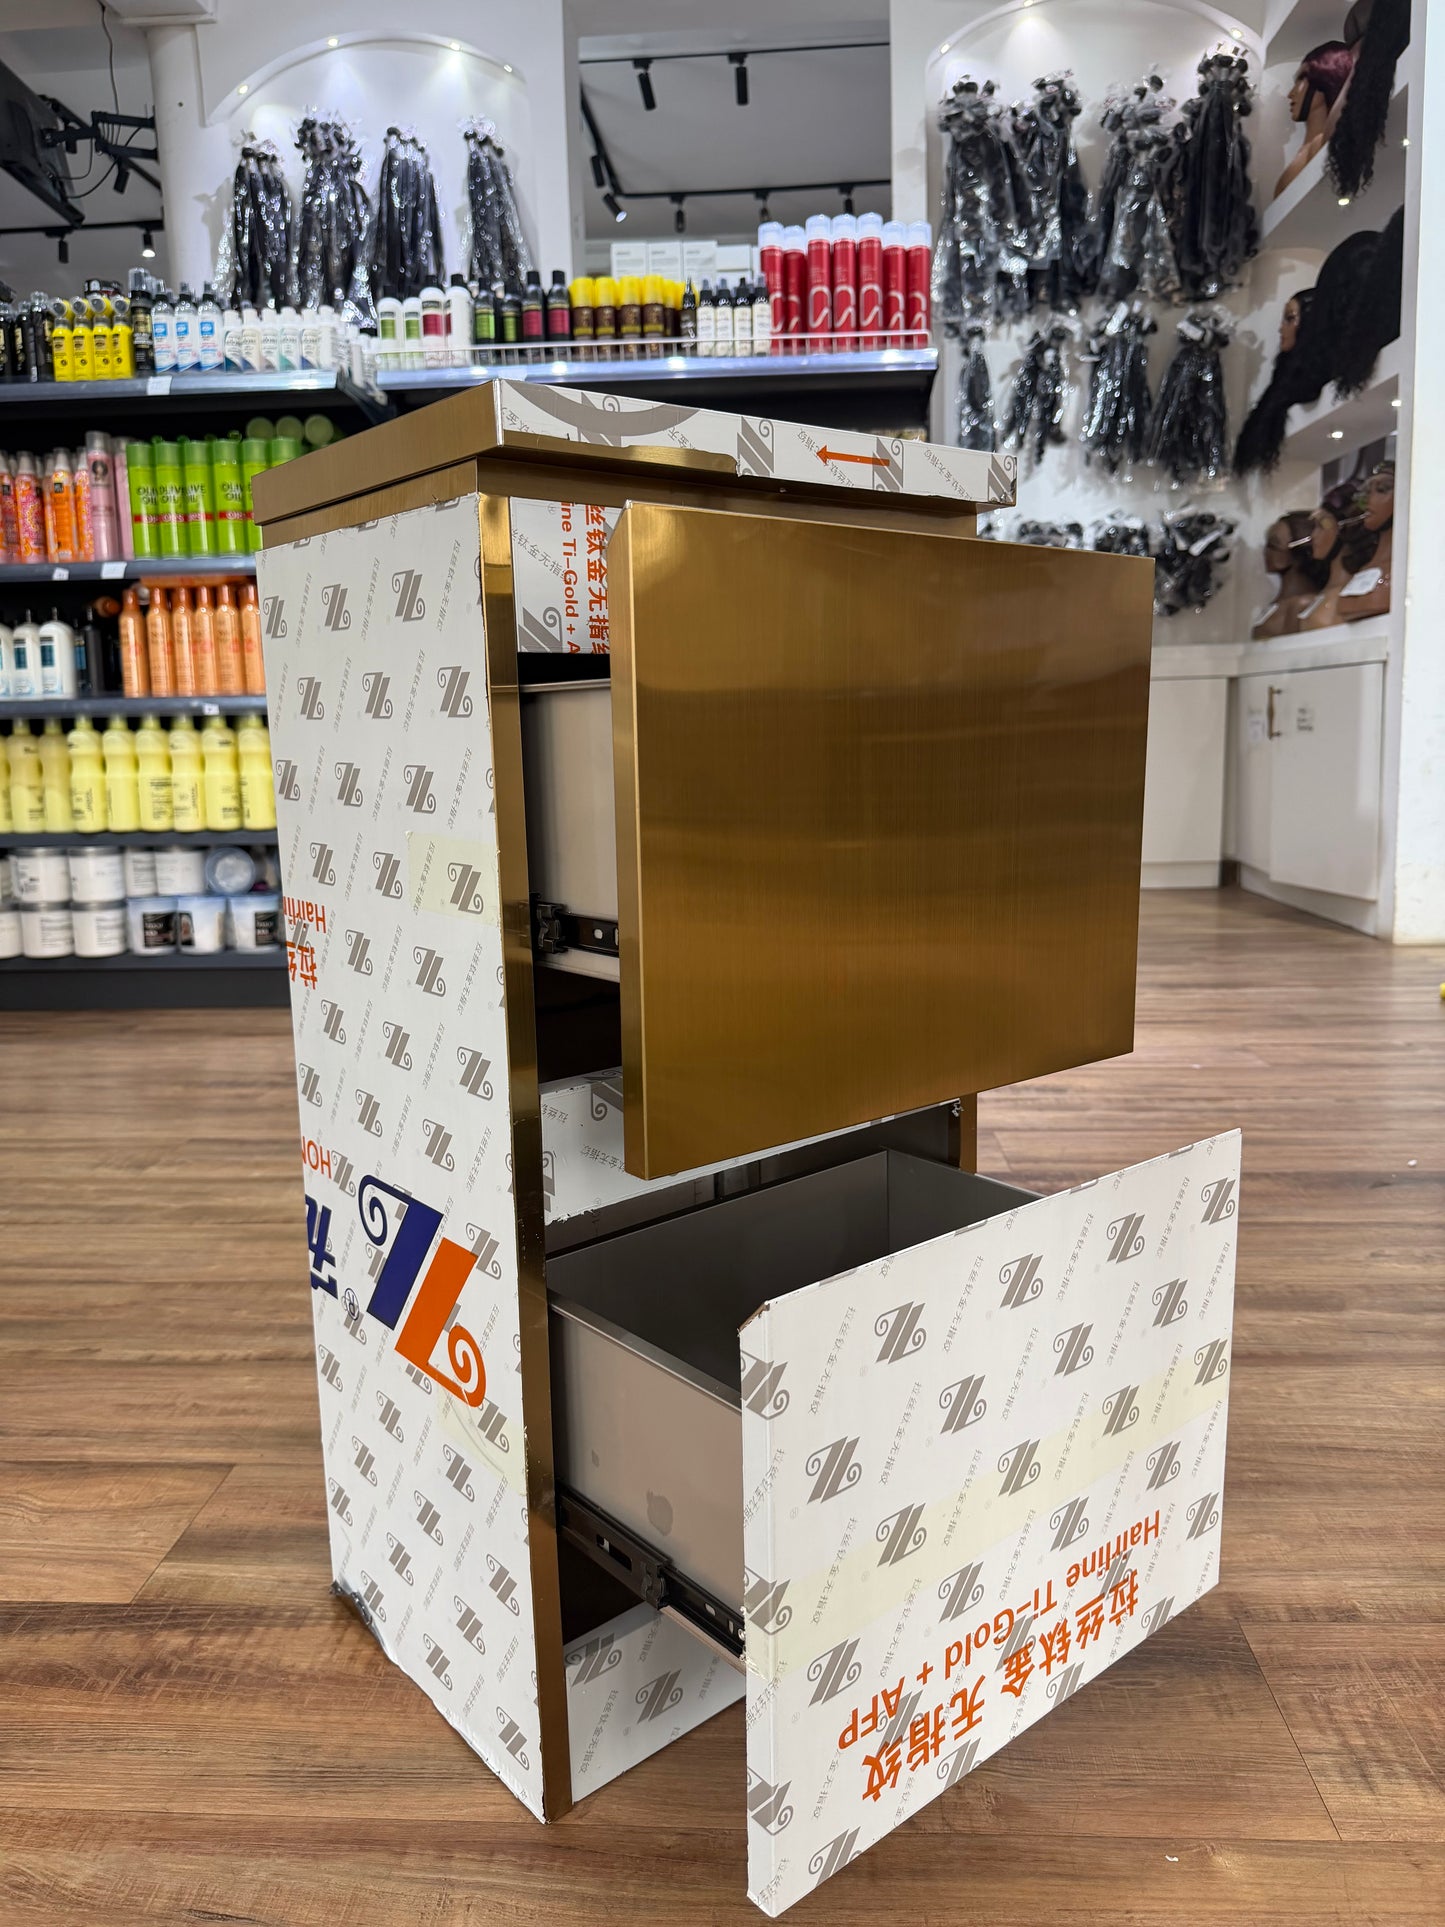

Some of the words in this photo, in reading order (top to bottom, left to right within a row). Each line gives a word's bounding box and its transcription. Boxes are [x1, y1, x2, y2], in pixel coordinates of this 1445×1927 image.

[1066, 1509, 1160, 1588] Hairline
[916, 1661, 934, 1686] +
[838, 1675, 905, 1750] AFP
